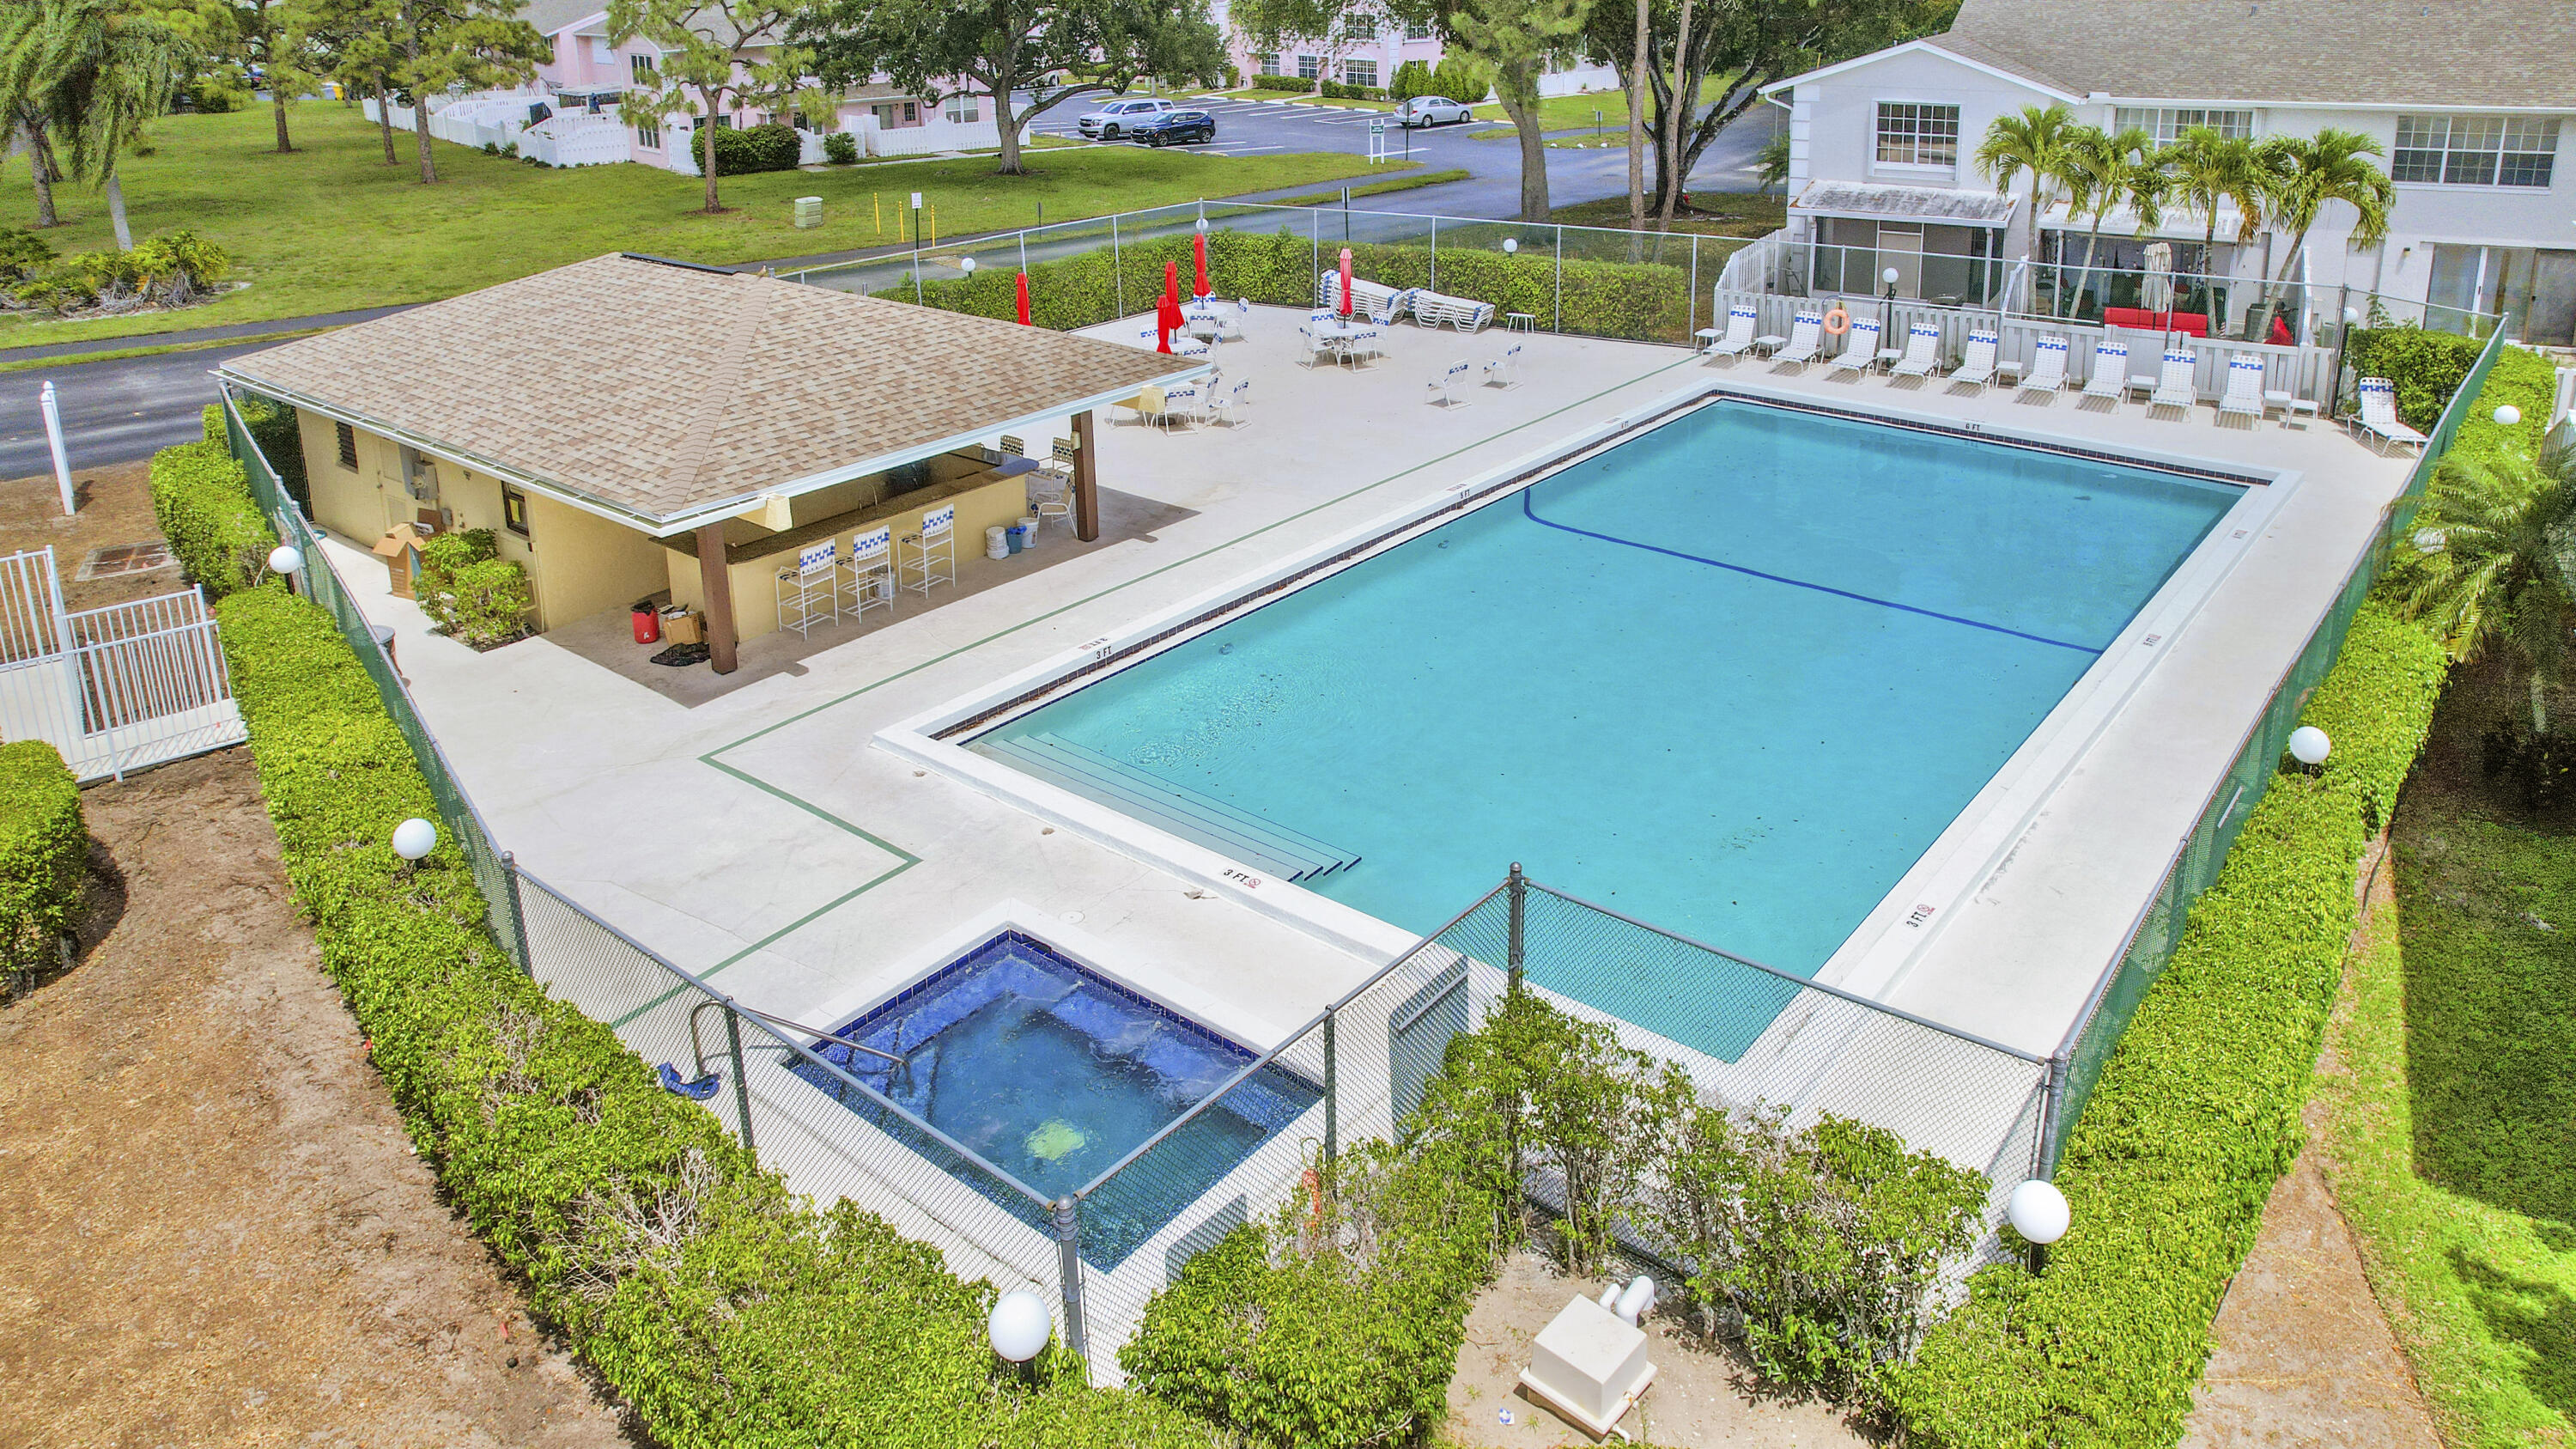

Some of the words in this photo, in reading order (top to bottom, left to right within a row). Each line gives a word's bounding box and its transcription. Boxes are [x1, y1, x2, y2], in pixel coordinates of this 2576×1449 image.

[1096, 650, 1101, 660] 3
[1103, 646, 1112, 657] FT
[1232, 873, 1250, 883] FT
[1911, 911, 1927, 922] FT
